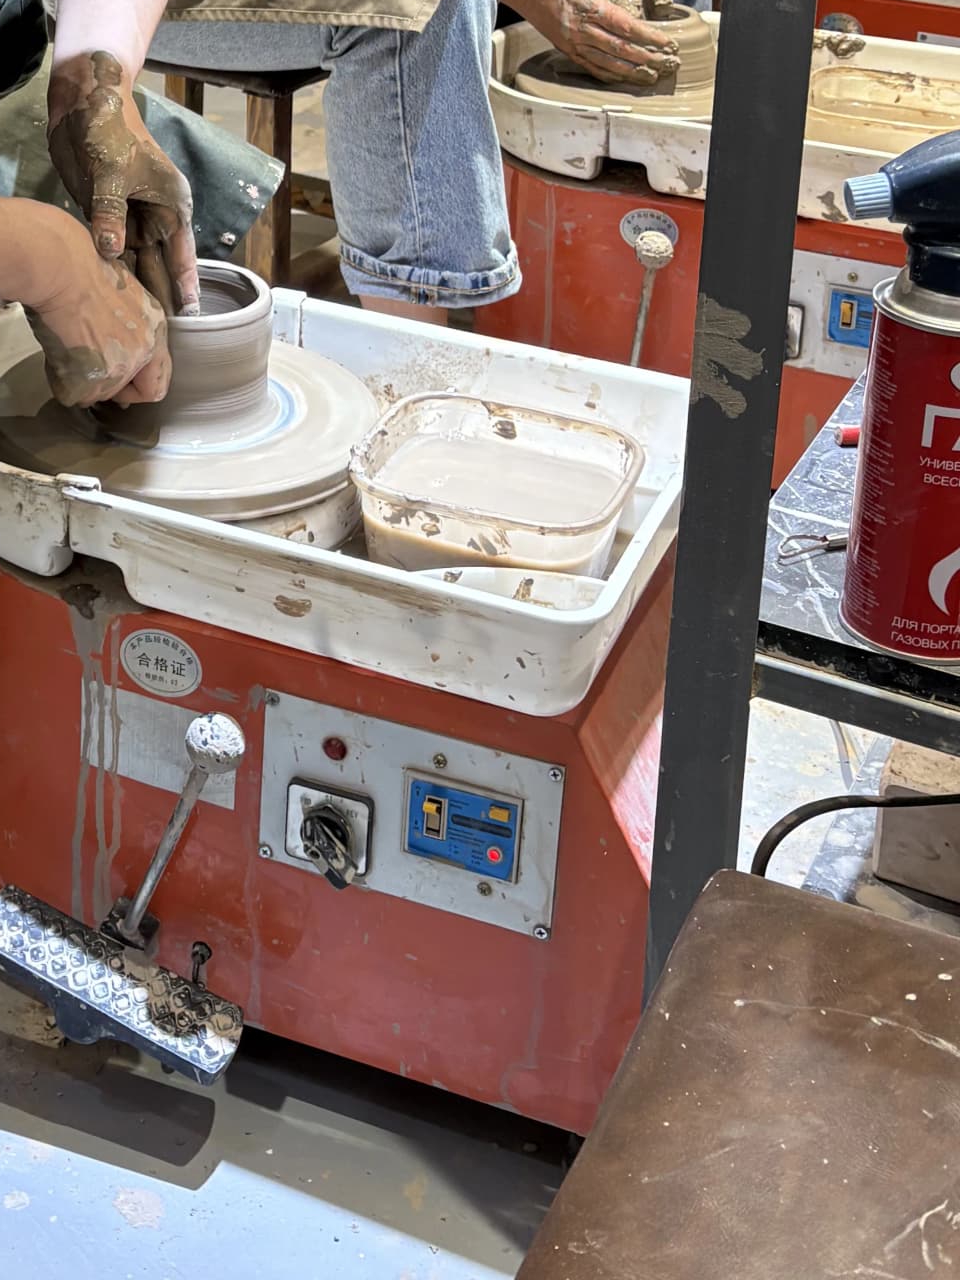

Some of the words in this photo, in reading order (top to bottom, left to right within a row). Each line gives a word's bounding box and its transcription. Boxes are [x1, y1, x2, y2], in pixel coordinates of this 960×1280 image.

[921, 403, 960, 451] Г
[923, 473, 960, 488] ВСЕС
[891, 615, 918, 631] ДЛЯ
[890, 631, 950, 650] ГАЗОВЫХ
[136, 652, 187, 677] 合格证
